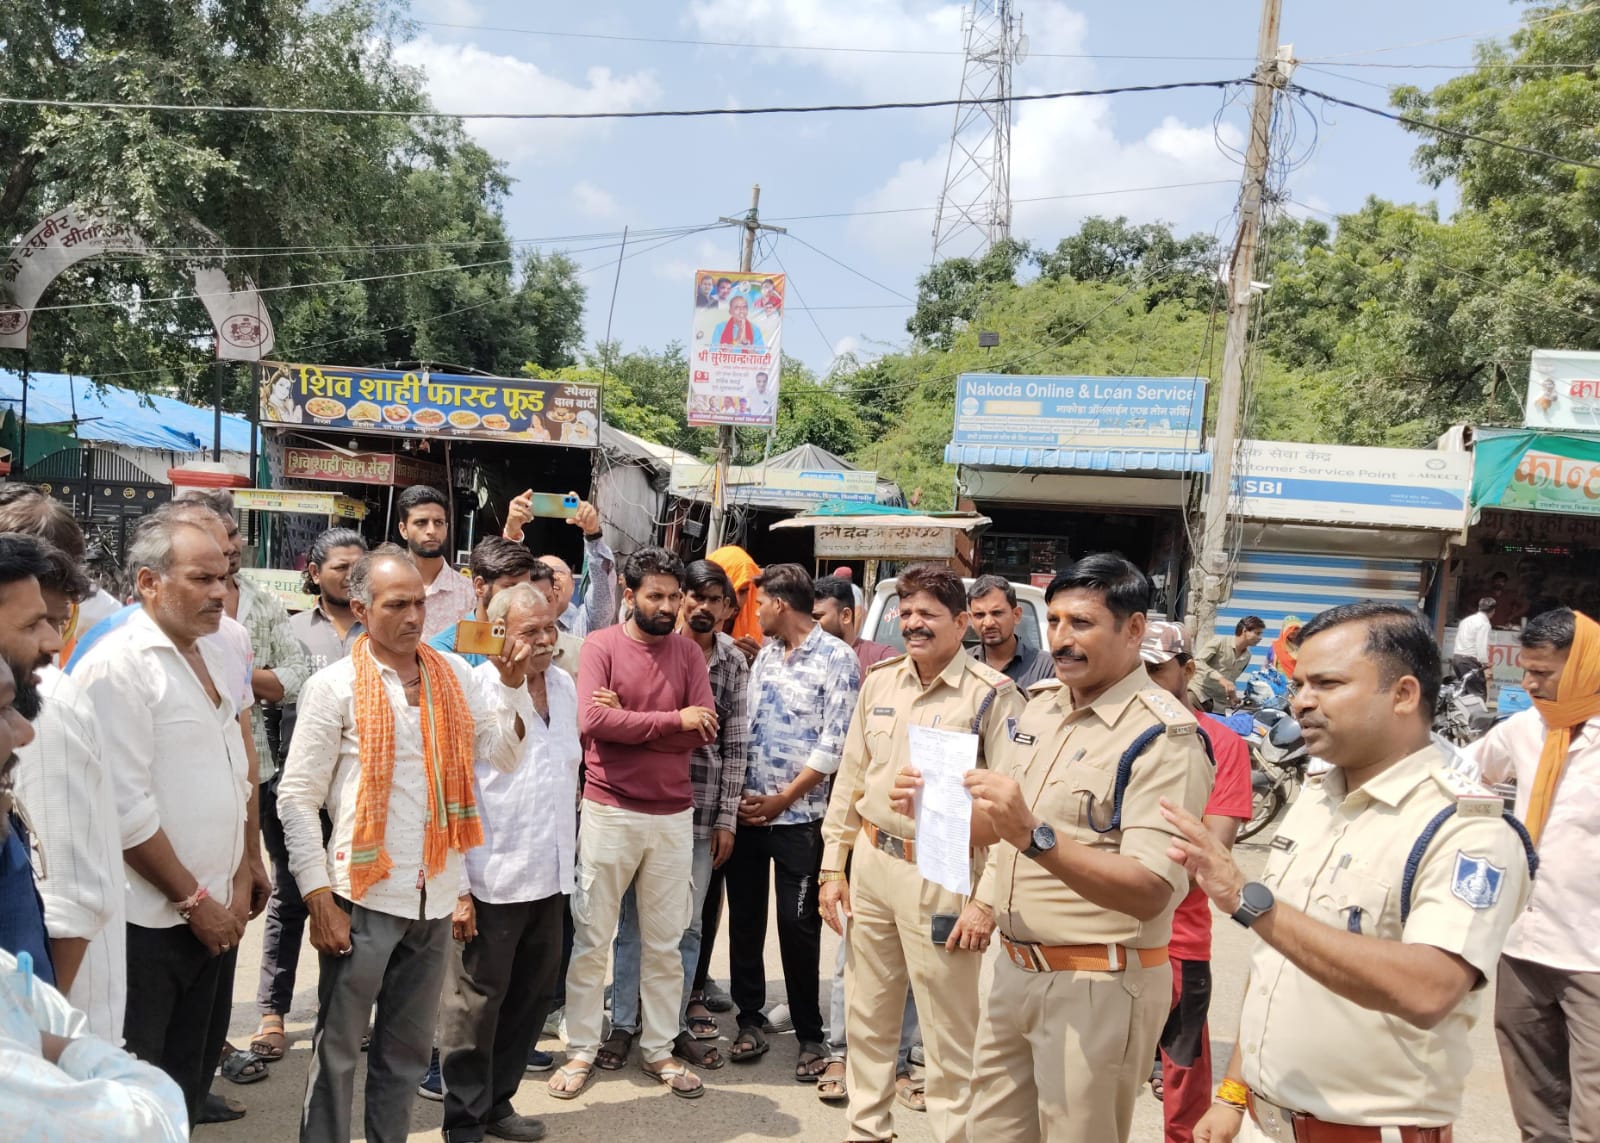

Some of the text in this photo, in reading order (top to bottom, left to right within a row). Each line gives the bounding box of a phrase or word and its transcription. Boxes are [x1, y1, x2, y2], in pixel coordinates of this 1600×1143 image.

[299, 365, 545, 420] शिव शाही फास्ट फूड
[966, 382, 1196, 400] Nakoda Online & Loan Service
[1298, 465, 1354, 477] Service
[1359, 469, 1398, 480] Point
[1246, 480, 1283, 495] SBI
